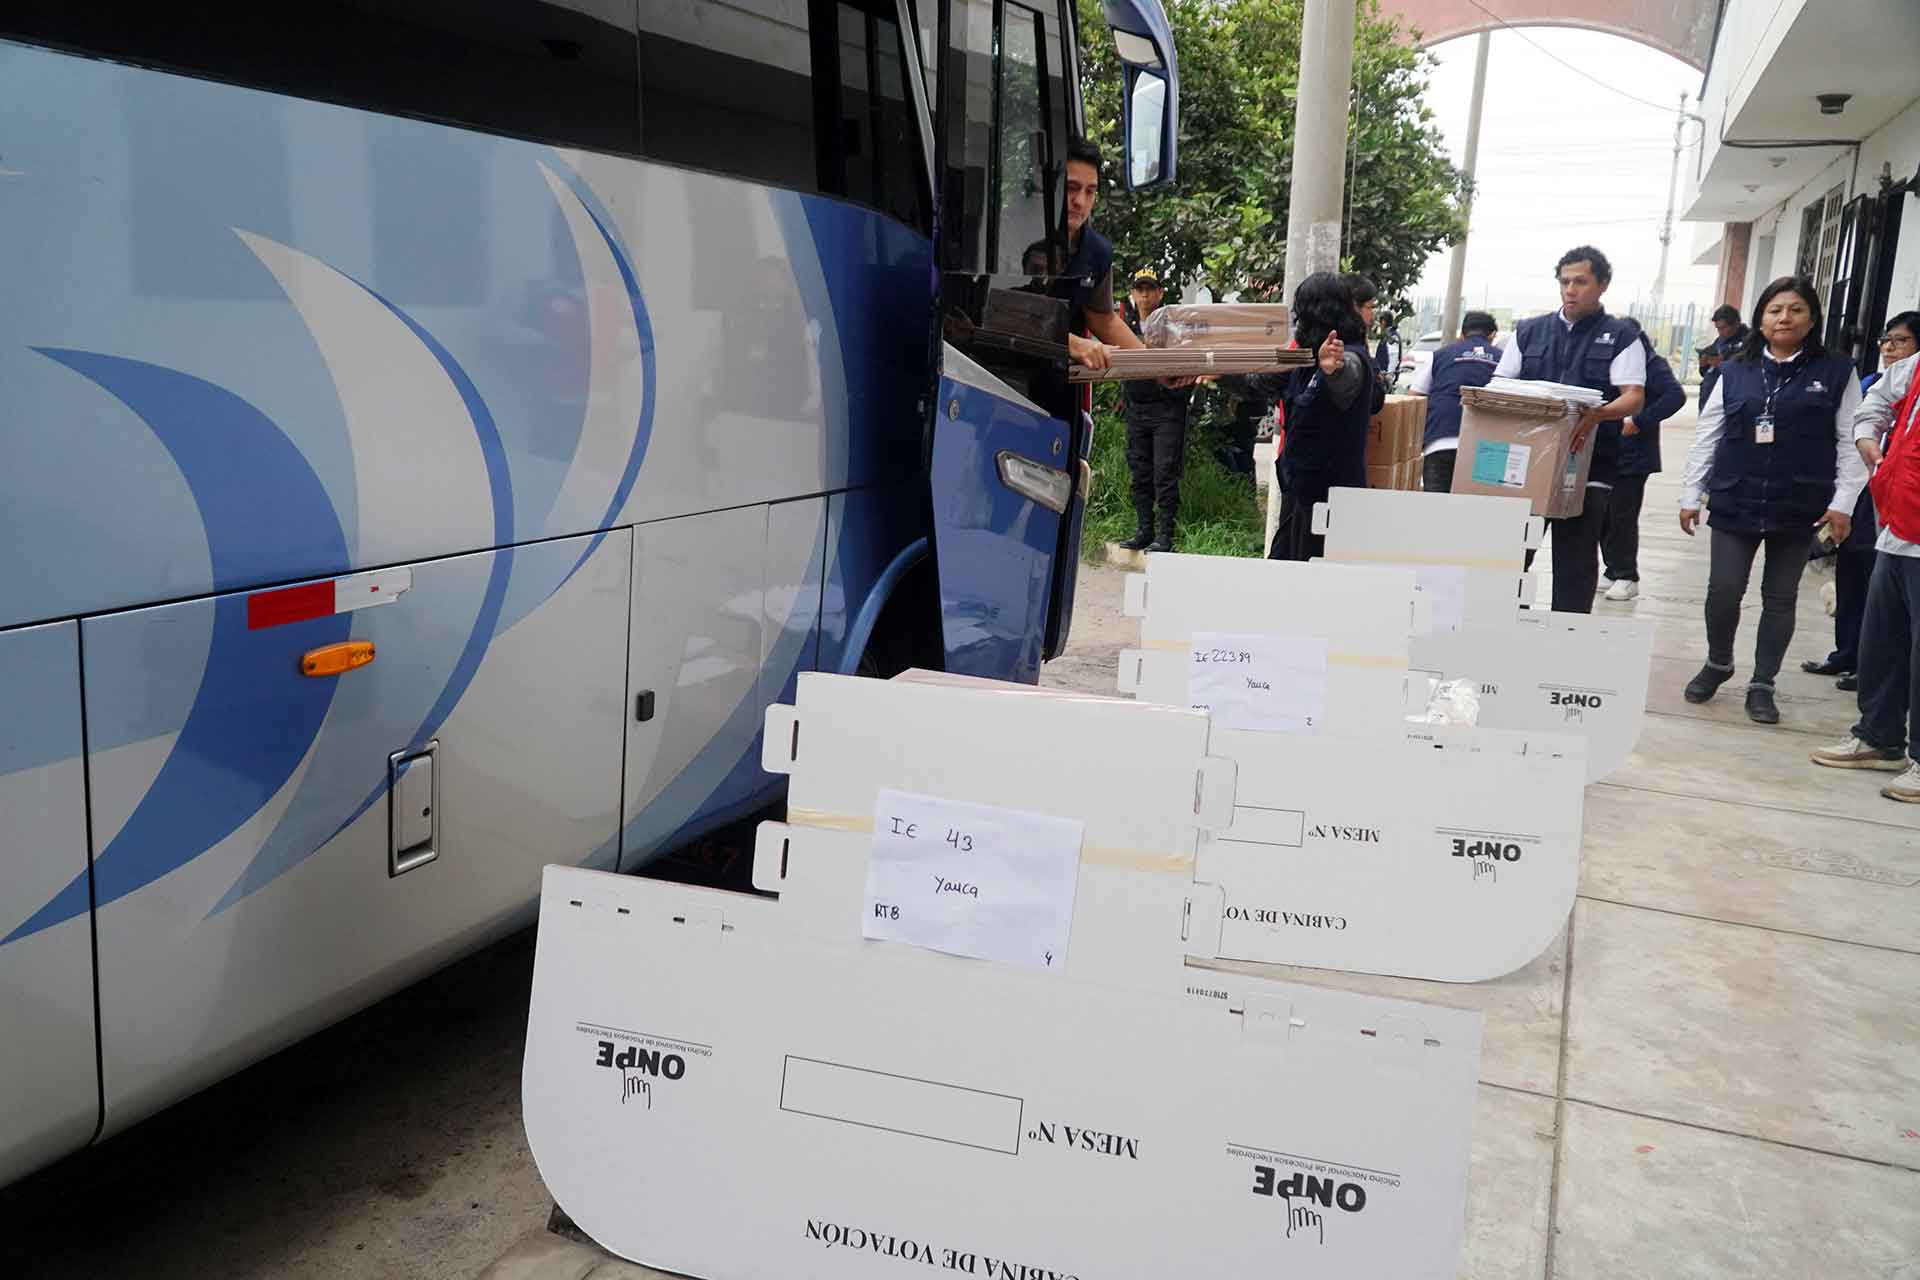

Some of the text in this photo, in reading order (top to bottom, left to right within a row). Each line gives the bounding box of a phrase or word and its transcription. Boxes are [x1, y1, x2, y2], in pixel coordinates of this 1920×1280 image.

[1550, 691, 1602, 709] ONPE
[946, 828, 973, 852] 43
[1332, 825, 1380, 843] MESA
[1451, 838, 1522, 863] ONPE
[934, 875, 979, 899] Yauca
[1255, 909, 1277, 924] DE
[1282, 911, 1347, 930] CABINA
[596, 1040, 686, 1080] ONPE
[1064, 1125, 1140, 1161] MESA
[1226, 1147, 1401, 1188] Oficina Nacional de Procesos Electorales
[1252, 1165, 1367, 1213] ONPE
[805, 1218, 1080, 1280] BINA DE VOTACIÓN
